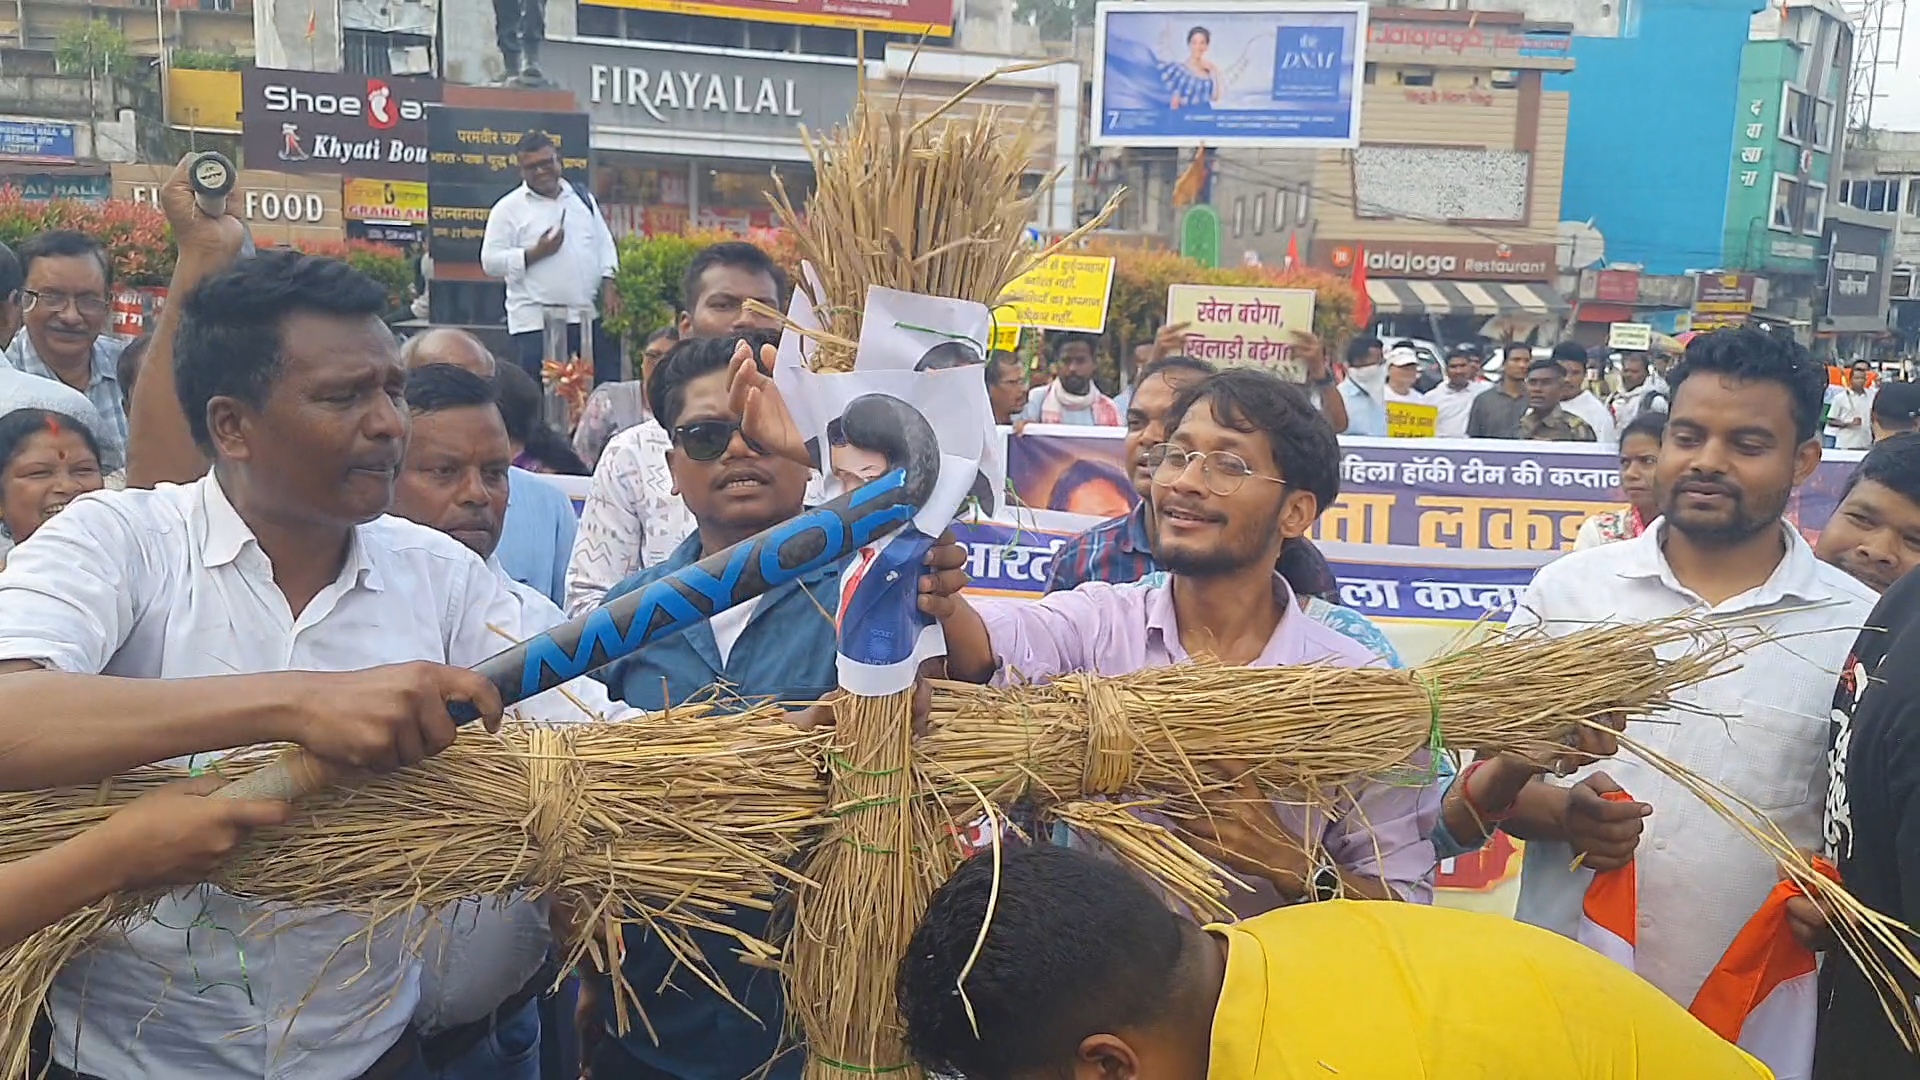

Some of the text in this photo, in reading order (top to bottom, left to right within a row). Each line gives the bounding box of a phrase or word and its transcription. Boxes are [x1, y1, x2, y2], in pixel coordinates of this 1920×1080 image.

[1377, 25, 1485, 56] Jalajoga
[264, 85, 362, 117] Shoe
[590, 64, 803, 123] FIRAYALAL
[313, 134, 428, 164] Khyati Bou
[457, 127, 498, 145] परमवीर
[53, 184, 101, 195] HALL
[245, 191, 324, 222] FOOD
[348, 205, 401, 217] GRAND
[1464, 258, 1547, 273] Restaurant
[1197, 295, 1285, 329] खेल बचेगा,
[1182, 332, 1244, 364] खिलाड़ी
[1401, 456, 1457, 487] हॉकी
[1460, 457, 1506, 485] टीम
[1511, 459, 1543, 488] की
